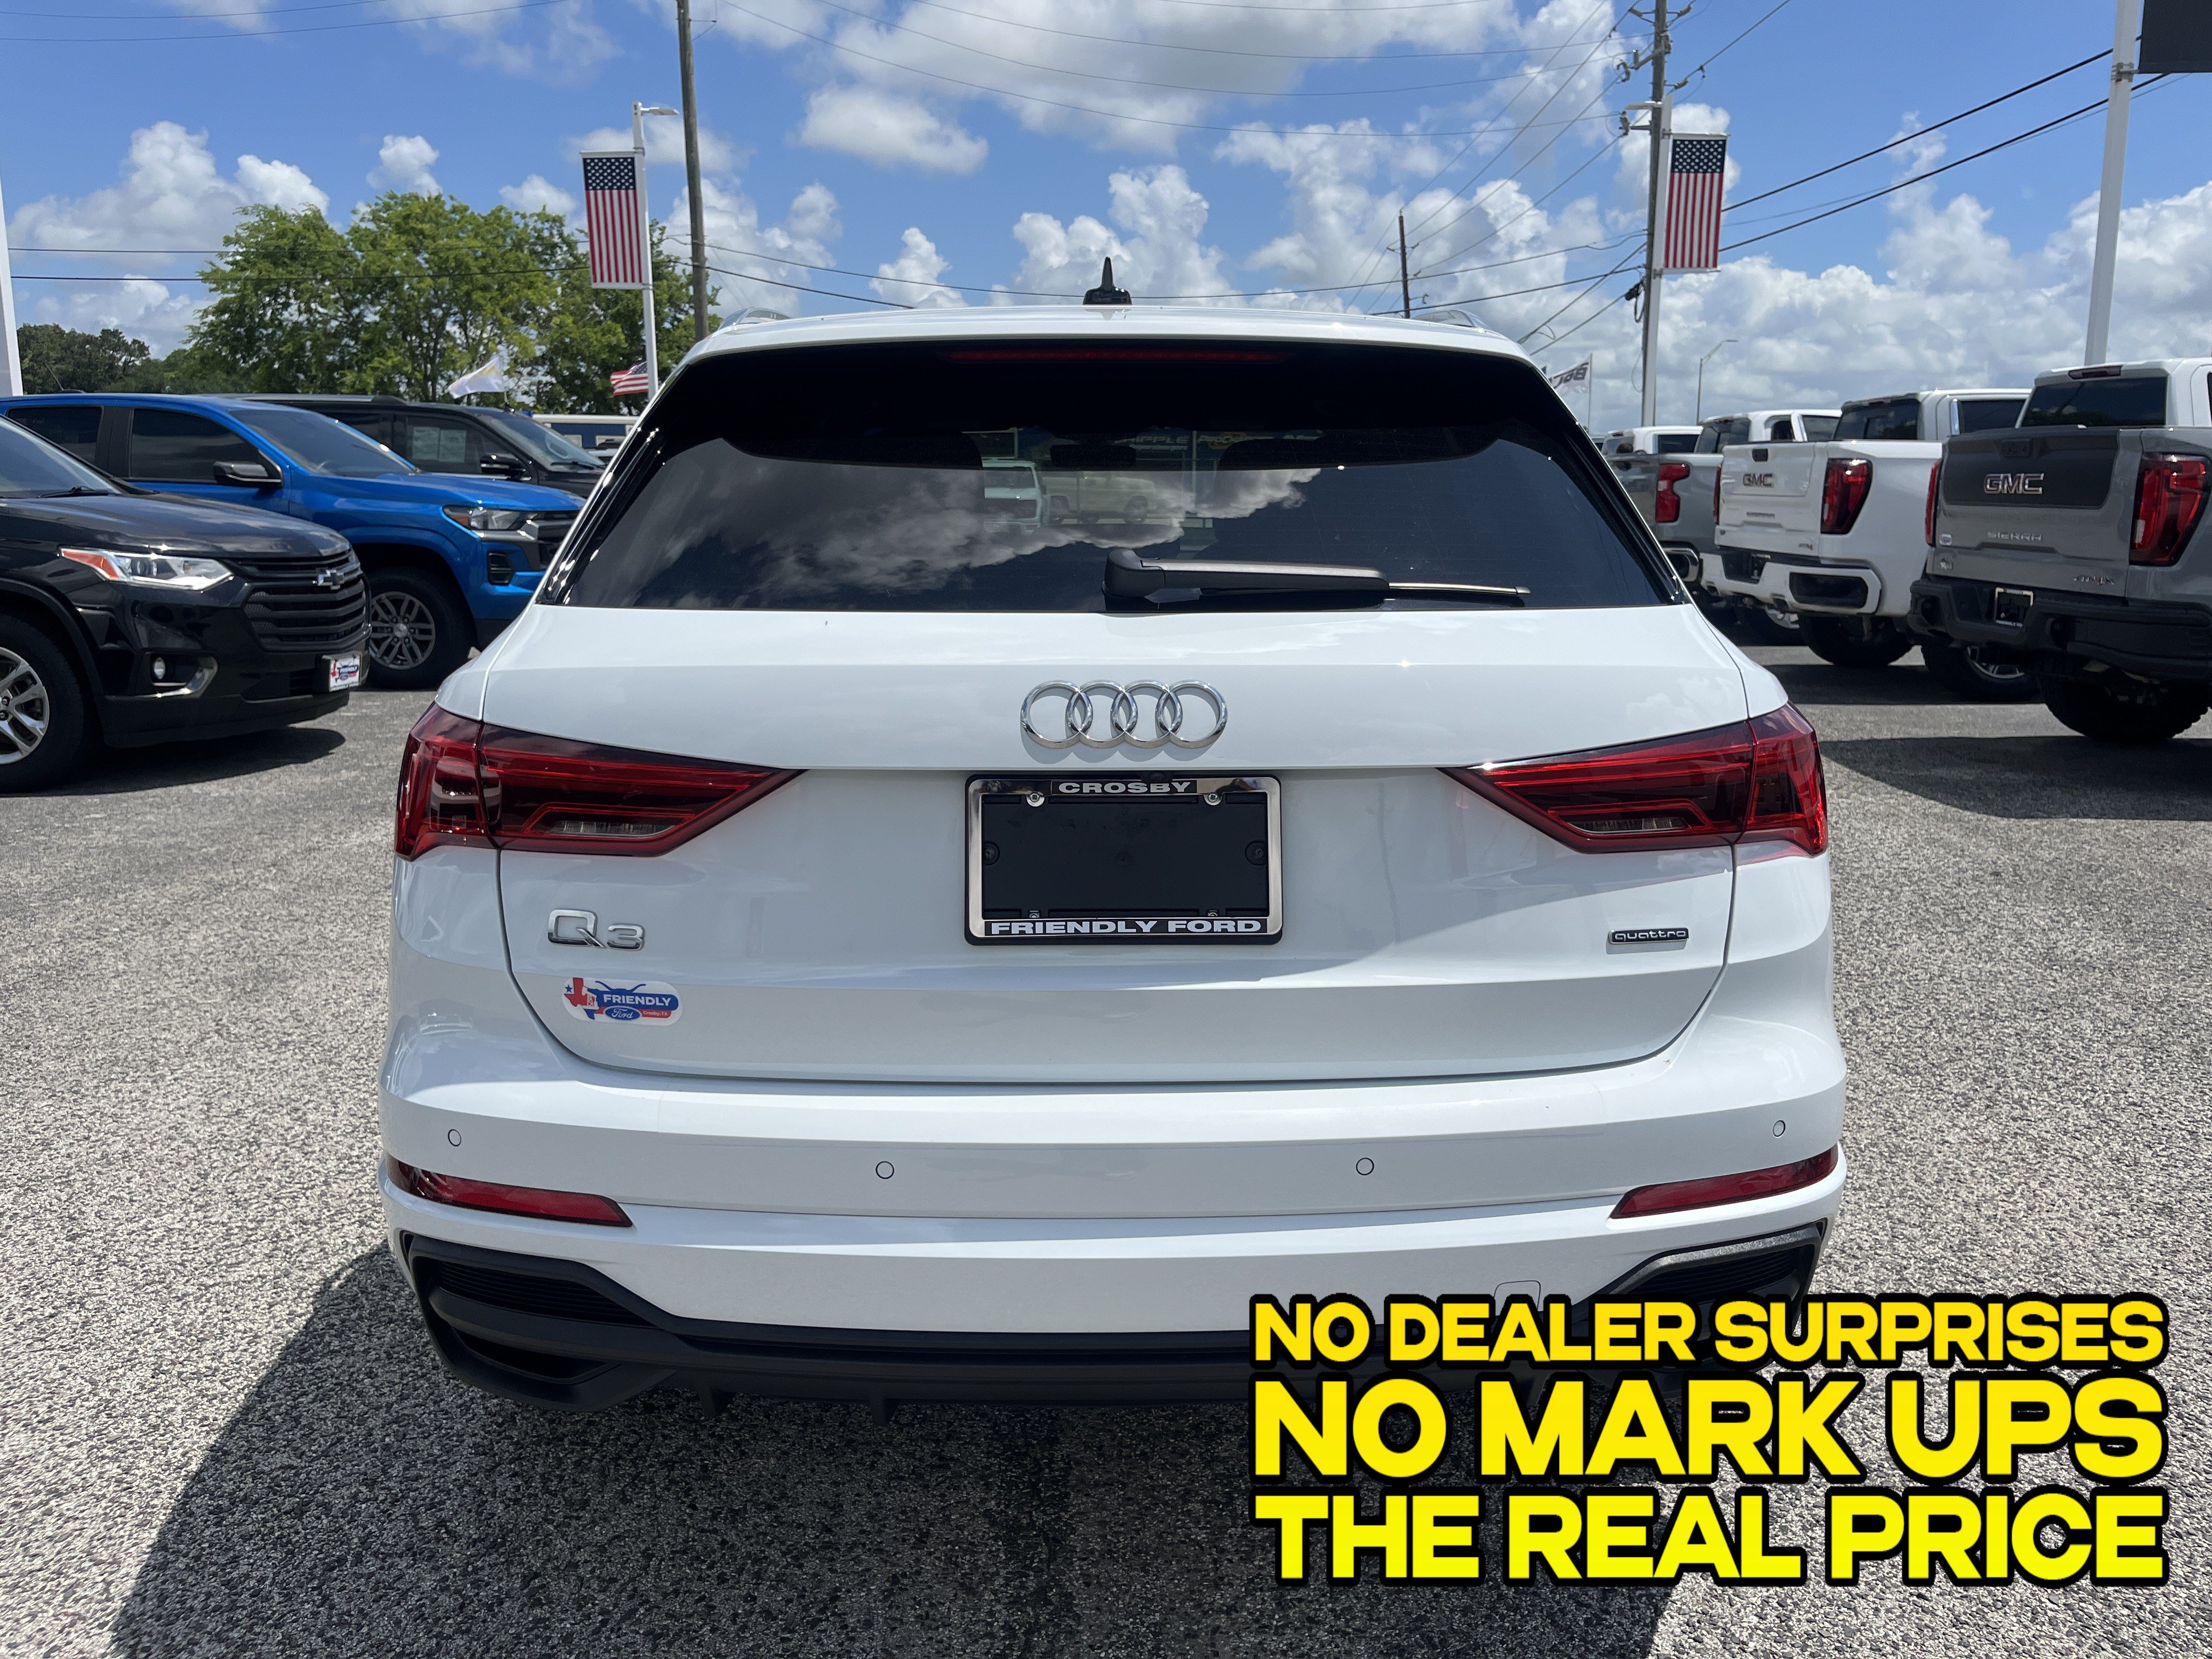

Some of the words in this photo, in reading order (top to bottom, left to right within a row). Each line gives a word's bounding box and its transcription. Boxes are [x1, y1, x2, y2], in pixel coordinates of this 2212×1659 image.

[1743, 473, 1774, 487] GMC
[1984, 473, 2044, 494] GMC
[1058, 782, 1190, 794] CROSBY
[548, 909, 645, 951] Q3
[992, 921, 1158, 934] FRIENDLY
[1168, 920, 1261, 932] FORD
[1615, 930, 1686, 942] quattro
[603, 994, 671, 1006] FRIENDLY
[612, 1008, 634, 1019] Ford
